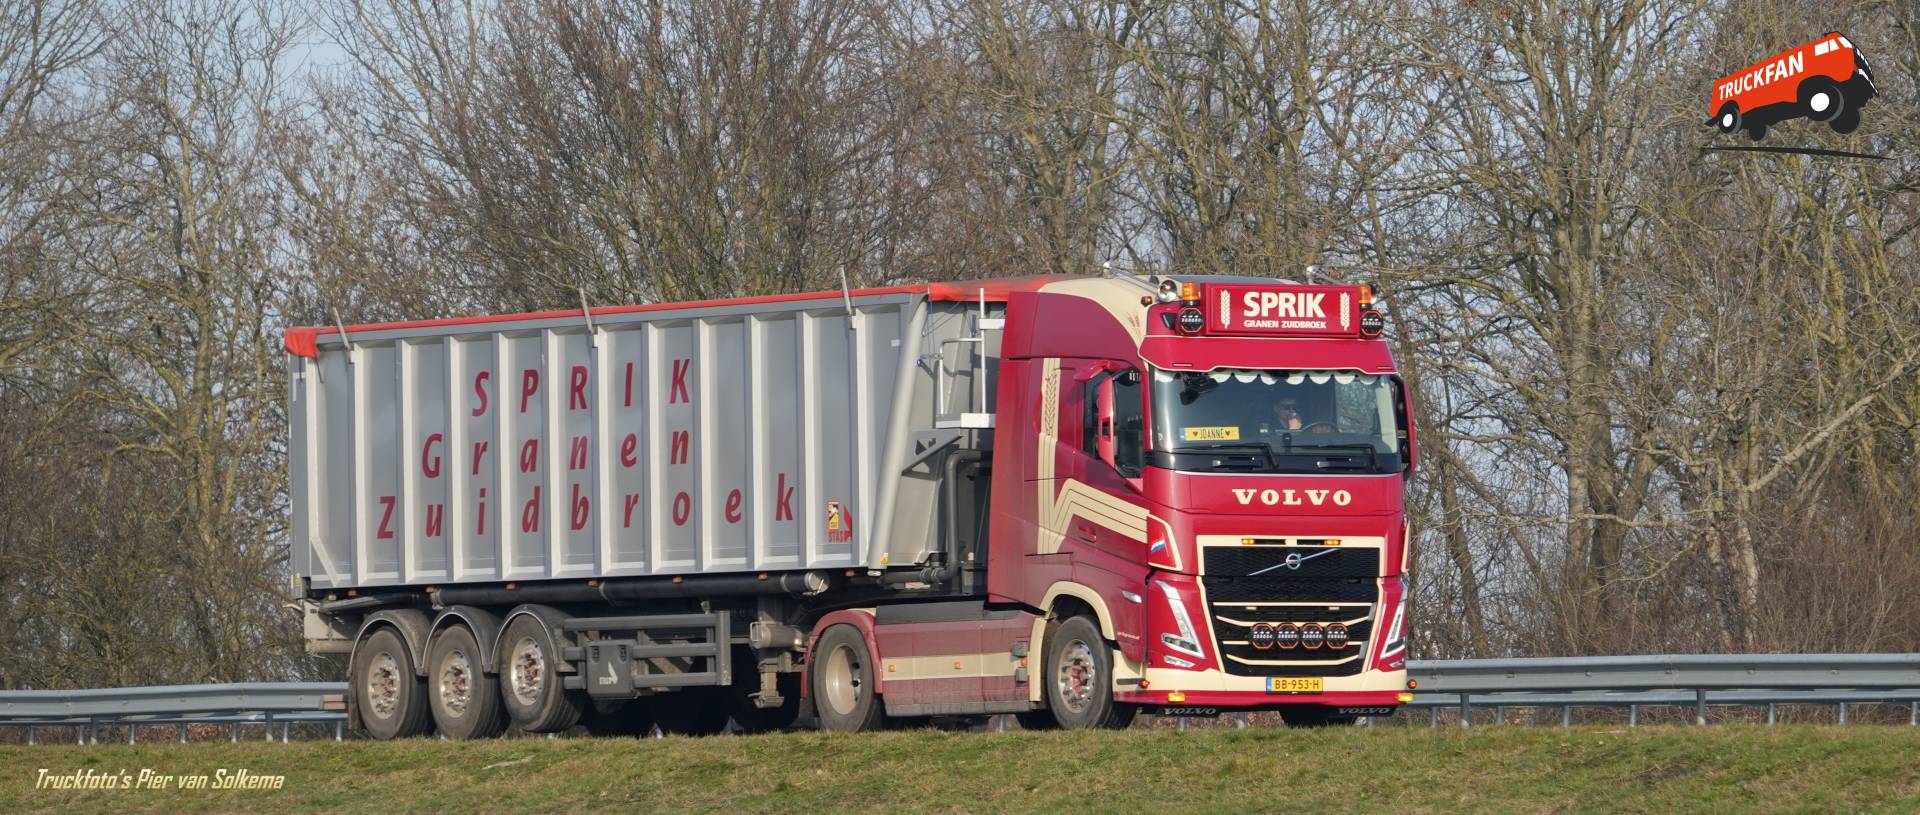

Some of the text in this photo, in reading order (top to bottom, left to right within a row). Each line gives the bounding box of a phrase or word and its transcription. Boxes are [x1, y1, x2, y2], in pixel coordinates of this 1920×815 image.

[1243, 291, 1327, 318] SPRIK
[1243, 320, 1327, 329] GRANEN ZUIDBROEK
[472, 358, 691, 418] SPRIK
[1200, 428, 1224, 439] JOANNE
[422, 429, 690, 479] Granen
[1232, 488, 1352, 506] VOLVO
[376, 471, 796, 540] Zuidbroek
[1275, 679, 1320, 690] BB-953-H
[1163, 706, 1217, 716] VOLVO
[1338, 706, 1390, 716] VOLVO
